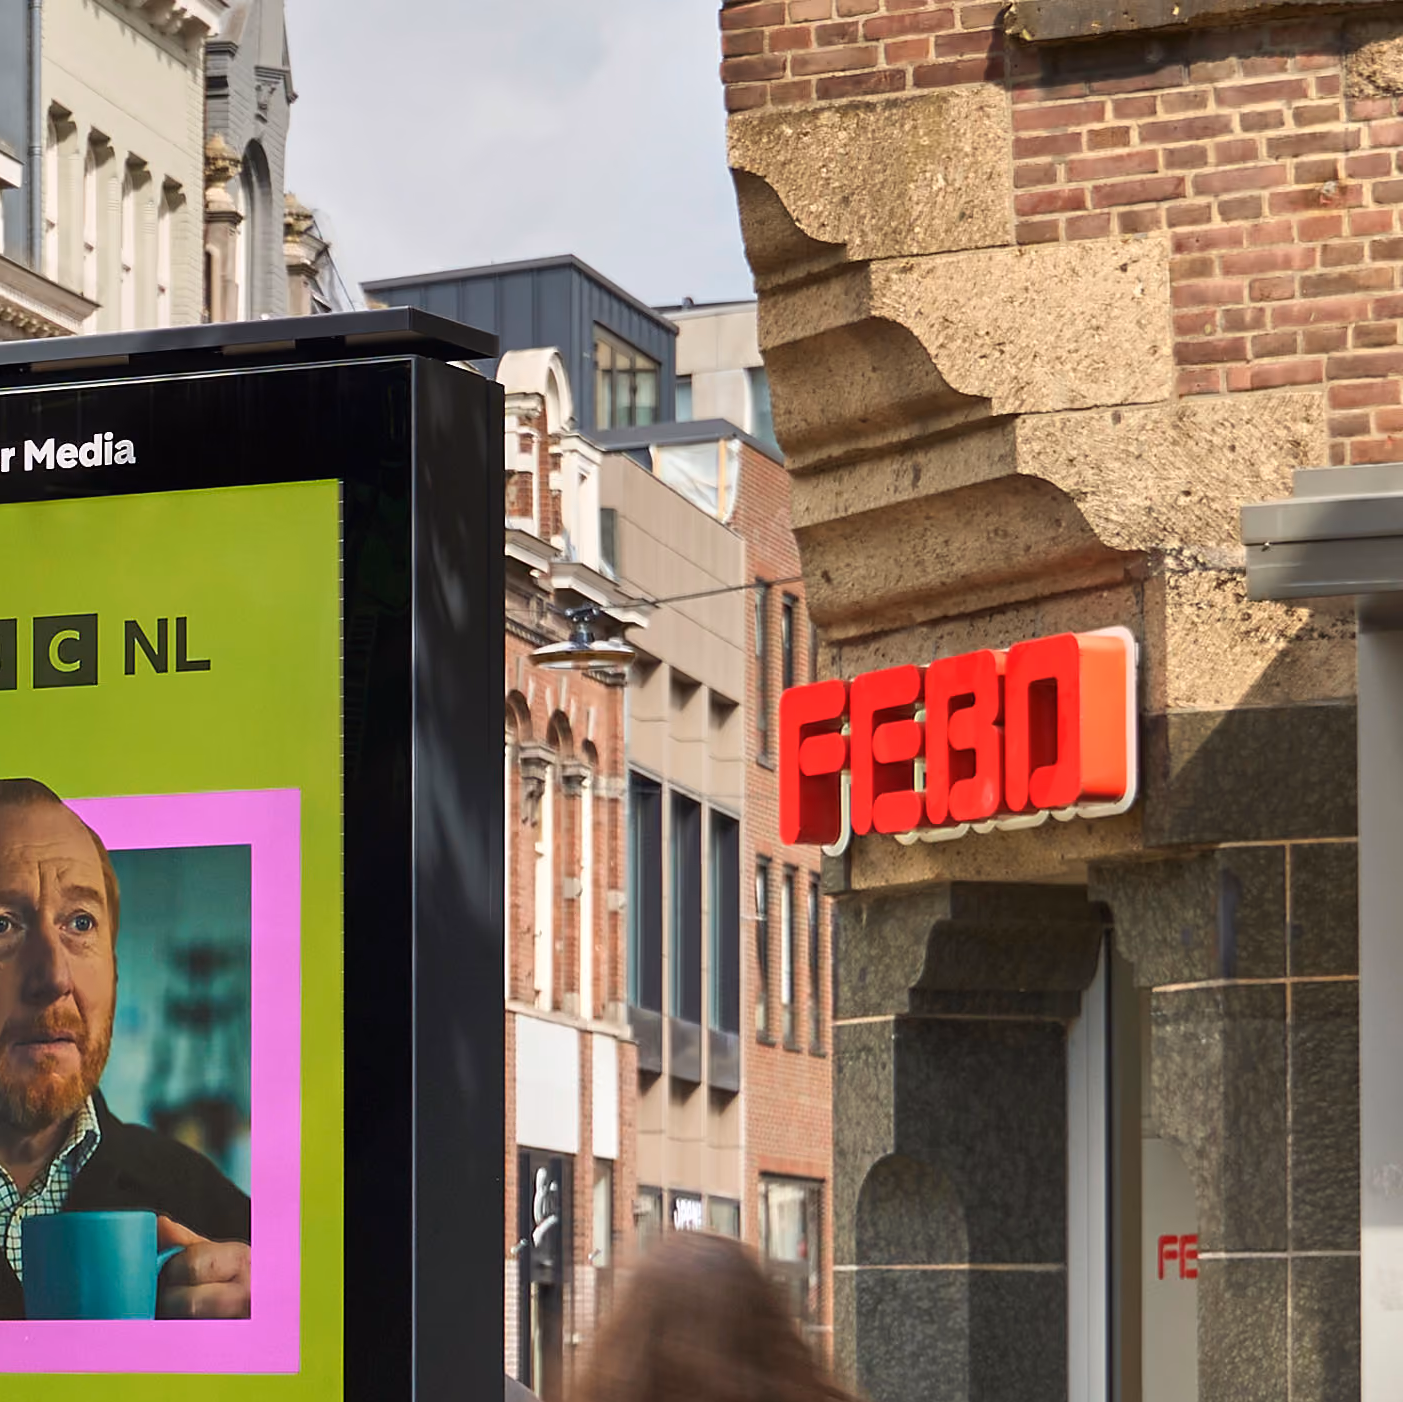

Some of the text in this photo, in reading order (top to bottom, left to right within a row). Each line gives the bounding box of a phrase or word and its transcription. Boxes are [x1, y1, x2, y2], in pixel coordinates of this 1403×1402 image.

[23, 431, 136, 471] Media
[123, 616, 211, 676] NL
[778, 631, 1087, 846] FEBO
